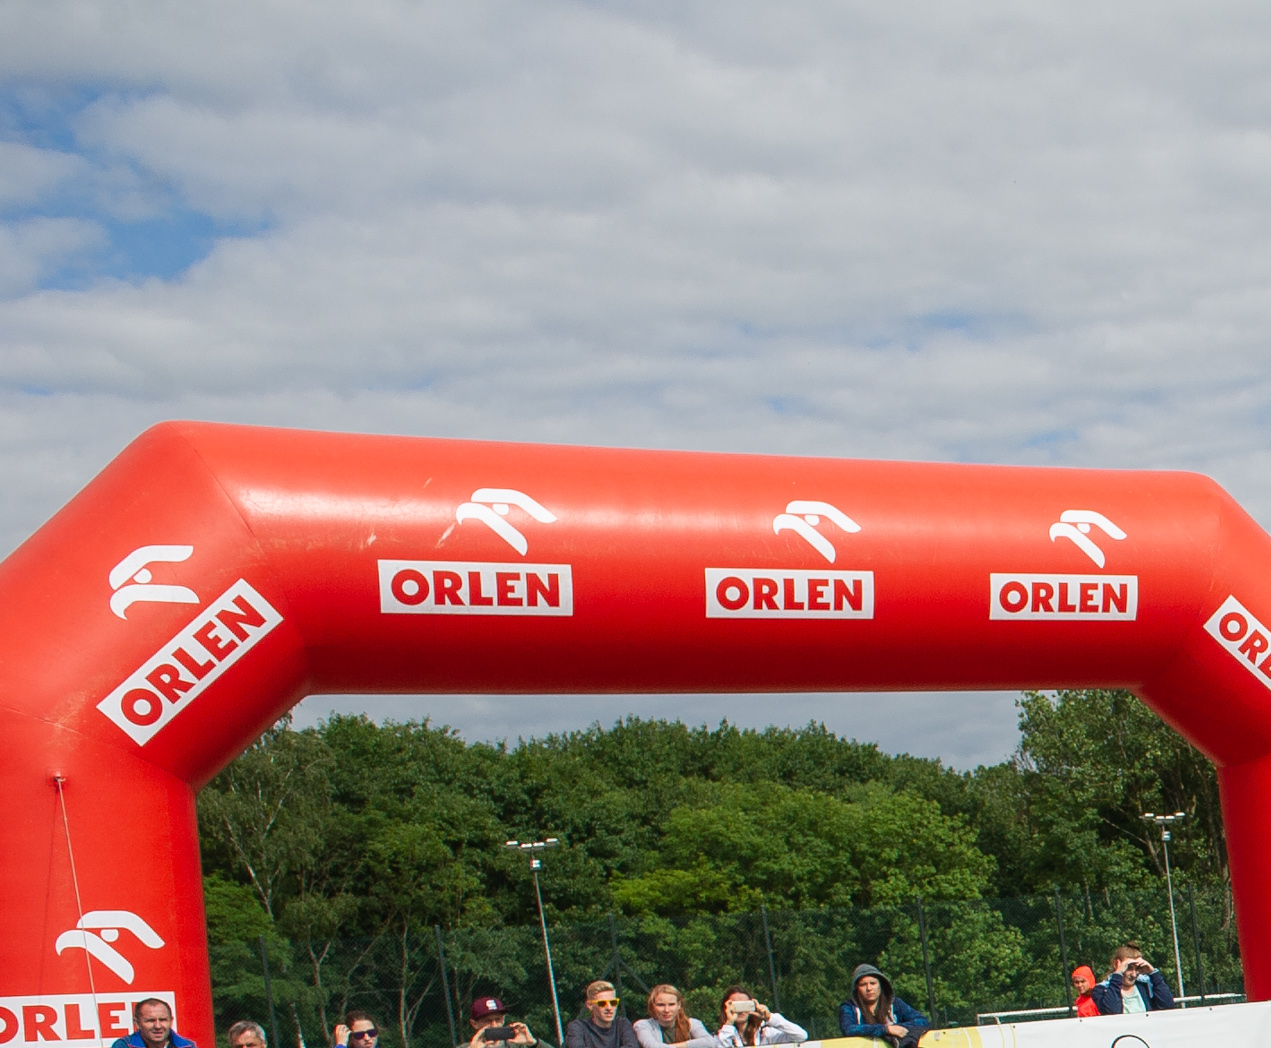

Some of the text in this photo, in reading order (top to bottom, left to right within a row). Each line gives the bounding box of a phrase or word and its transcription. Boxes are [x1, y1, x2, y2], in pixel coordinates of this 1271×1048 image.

[389, 568, 561, 608] ORLEN
[715, 576, 864, 611] ORLEN
[998, 580, 1128, 614] ORLEN
[120, 593, 268, 727] ORLEN
